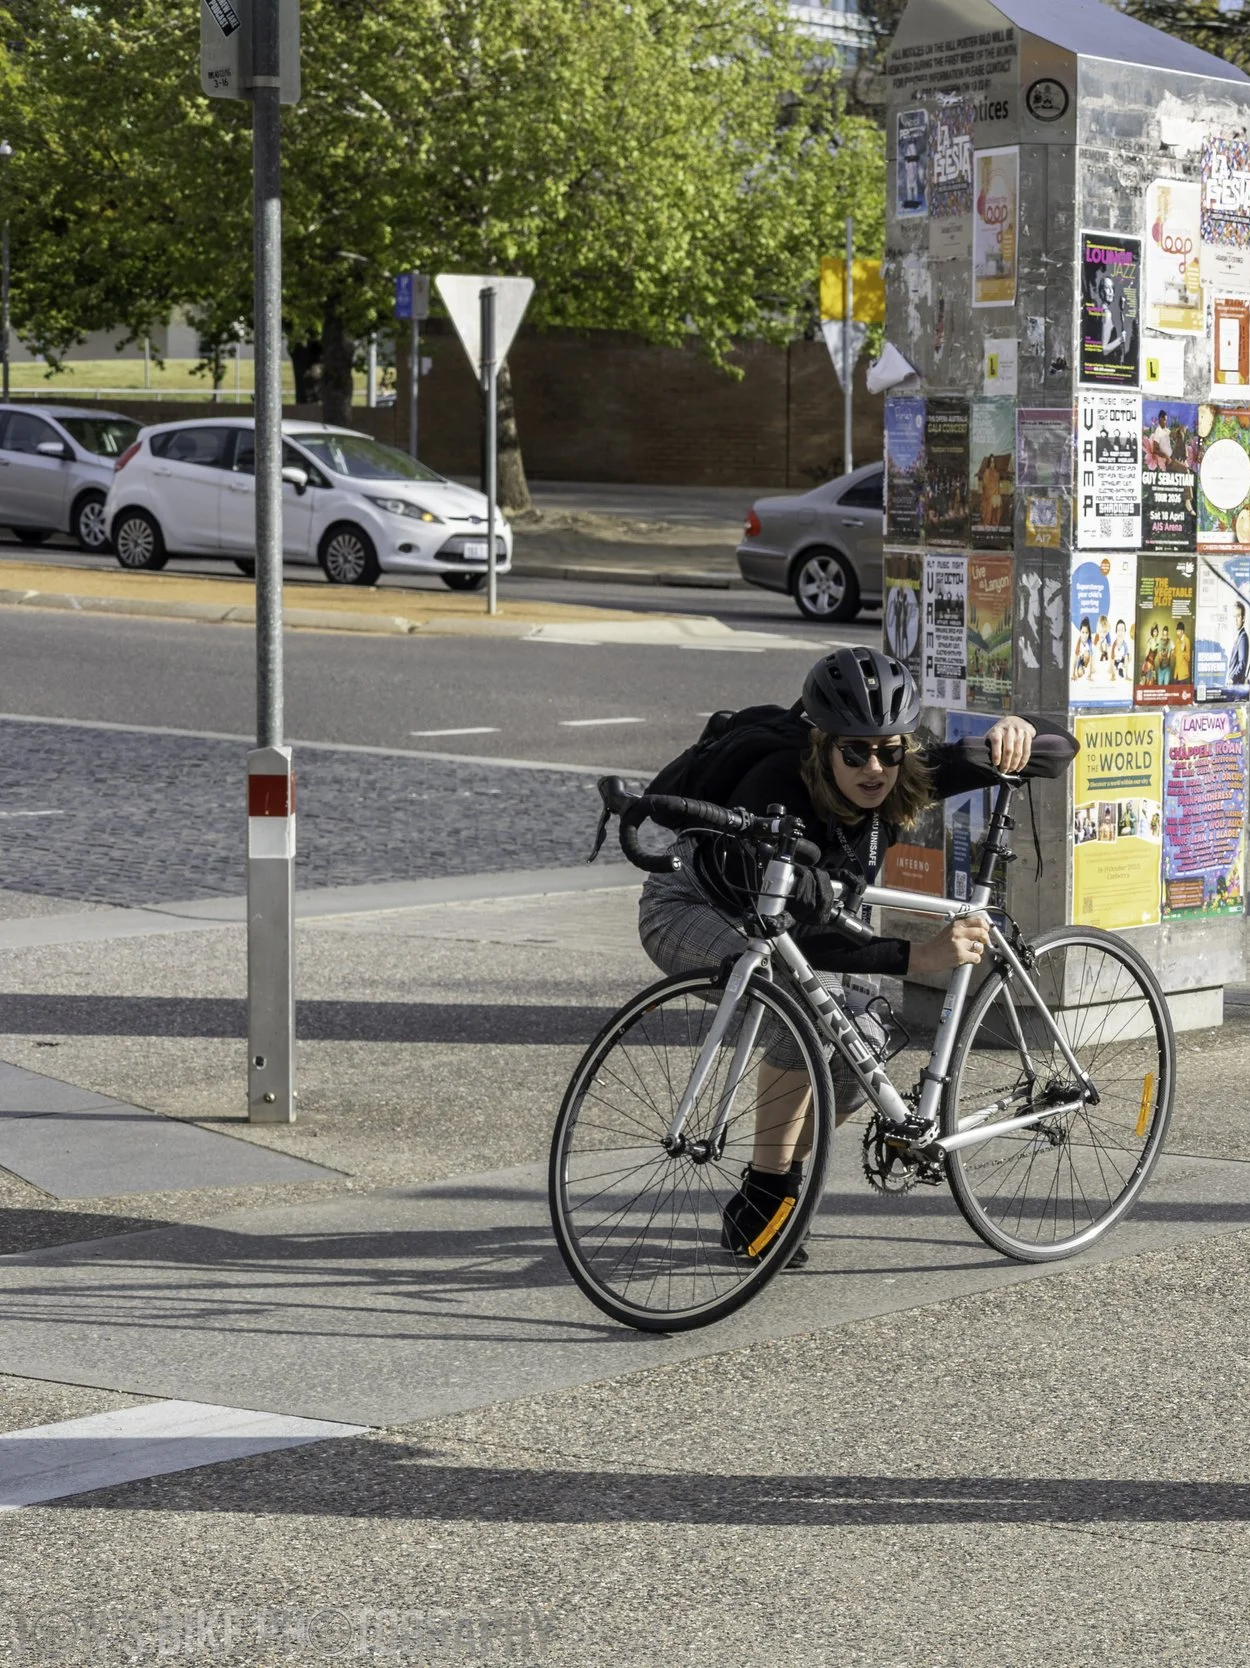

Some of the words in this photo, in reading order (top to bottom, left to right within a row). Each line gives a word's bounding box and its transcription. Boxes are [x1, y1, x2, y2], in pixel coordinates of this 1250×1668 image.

[934, 41, 944, 53] THE
[933, 57, 945, 68] THE
[1110, 263, 1136, 280] JAZZ
[1142, 471, 1157, 485] GUY
[1157, 472, 1195, 487] SEBASTIAN
[1154, 493, 1168, 503] TOUR
[1168, 493, 1182, 503] 2026
[1149, 510, 1161, 521] Sat
[1169, 511, 1185, 522] April
[1164, 522, 1183, 532] Arena
[971, 564, 987, 581] Live
[983, 575, 1010, 593] Lanyon
[1154, 577, 1169, 587] THE
[1154, 587, 1193, 598] VEGETABLE
[1153, 596, 1173, 607] PLOT
[1183, 717, 1226, 732] LANEWAY
[1085, 730, 1154, 749] WINDOWS
[1215, 741, 1242, 756] ROAN
[1087, 754, 1096, 762] TO
[1099, 751, 1152, 772] WORLD
[1087, 764, 1099, 773] THE
[1183, 807, 1200, 817] ROLE
[1201, 803, 1225, 815] MODEL
[1180, 825, 1193, 836] LEG
[868, 830, 879, 866] UNISAFE
[895, 857, 930, 873] INFERNO
[802, 964, 891, 1094] TREK
